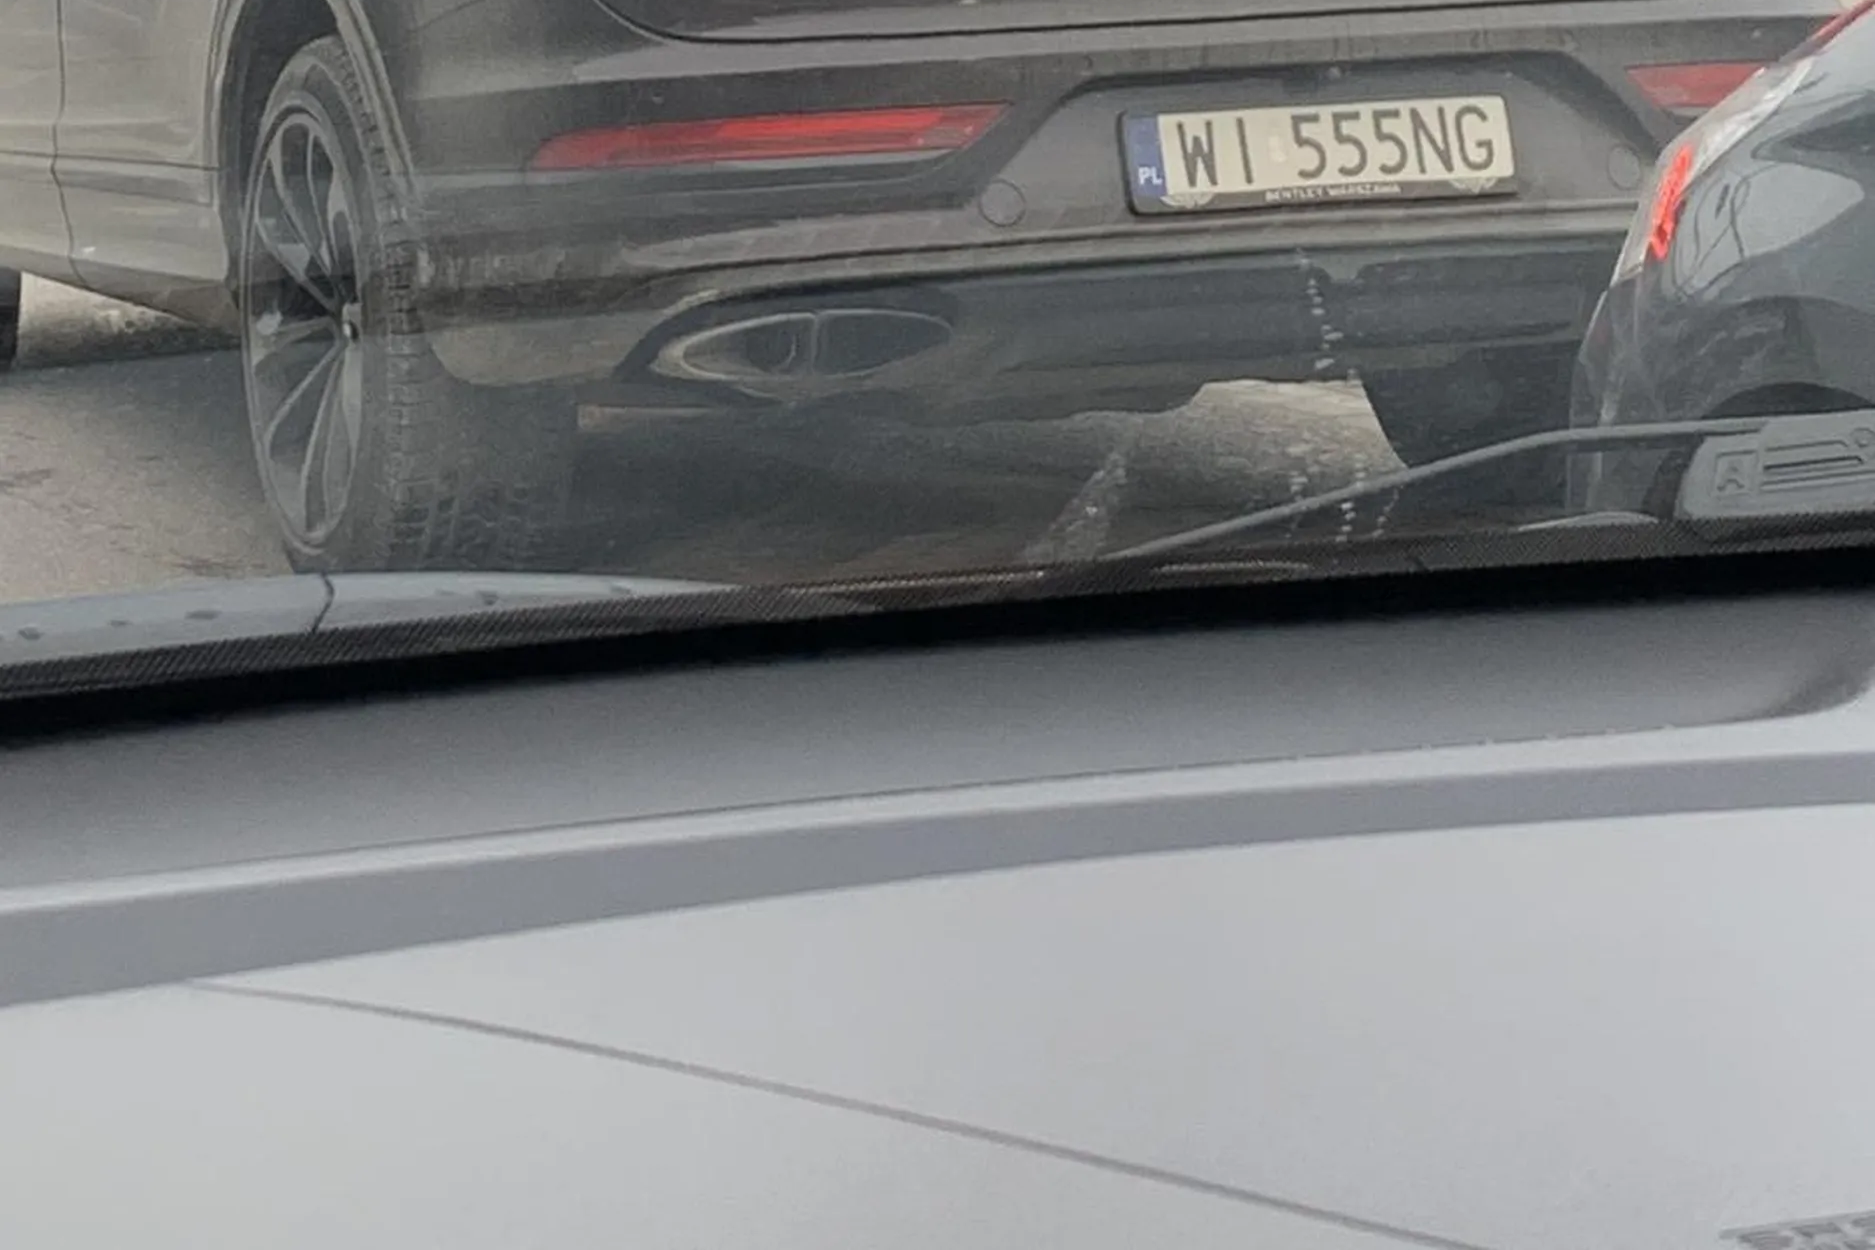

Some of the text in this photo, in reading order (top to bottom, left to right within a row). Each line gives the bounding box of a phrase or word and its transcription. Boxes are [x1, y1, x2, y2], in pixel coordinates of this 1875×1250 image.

[1177, 104, 1495, 188] WI 555NG
[1138, 167, 1163, 185] PL
